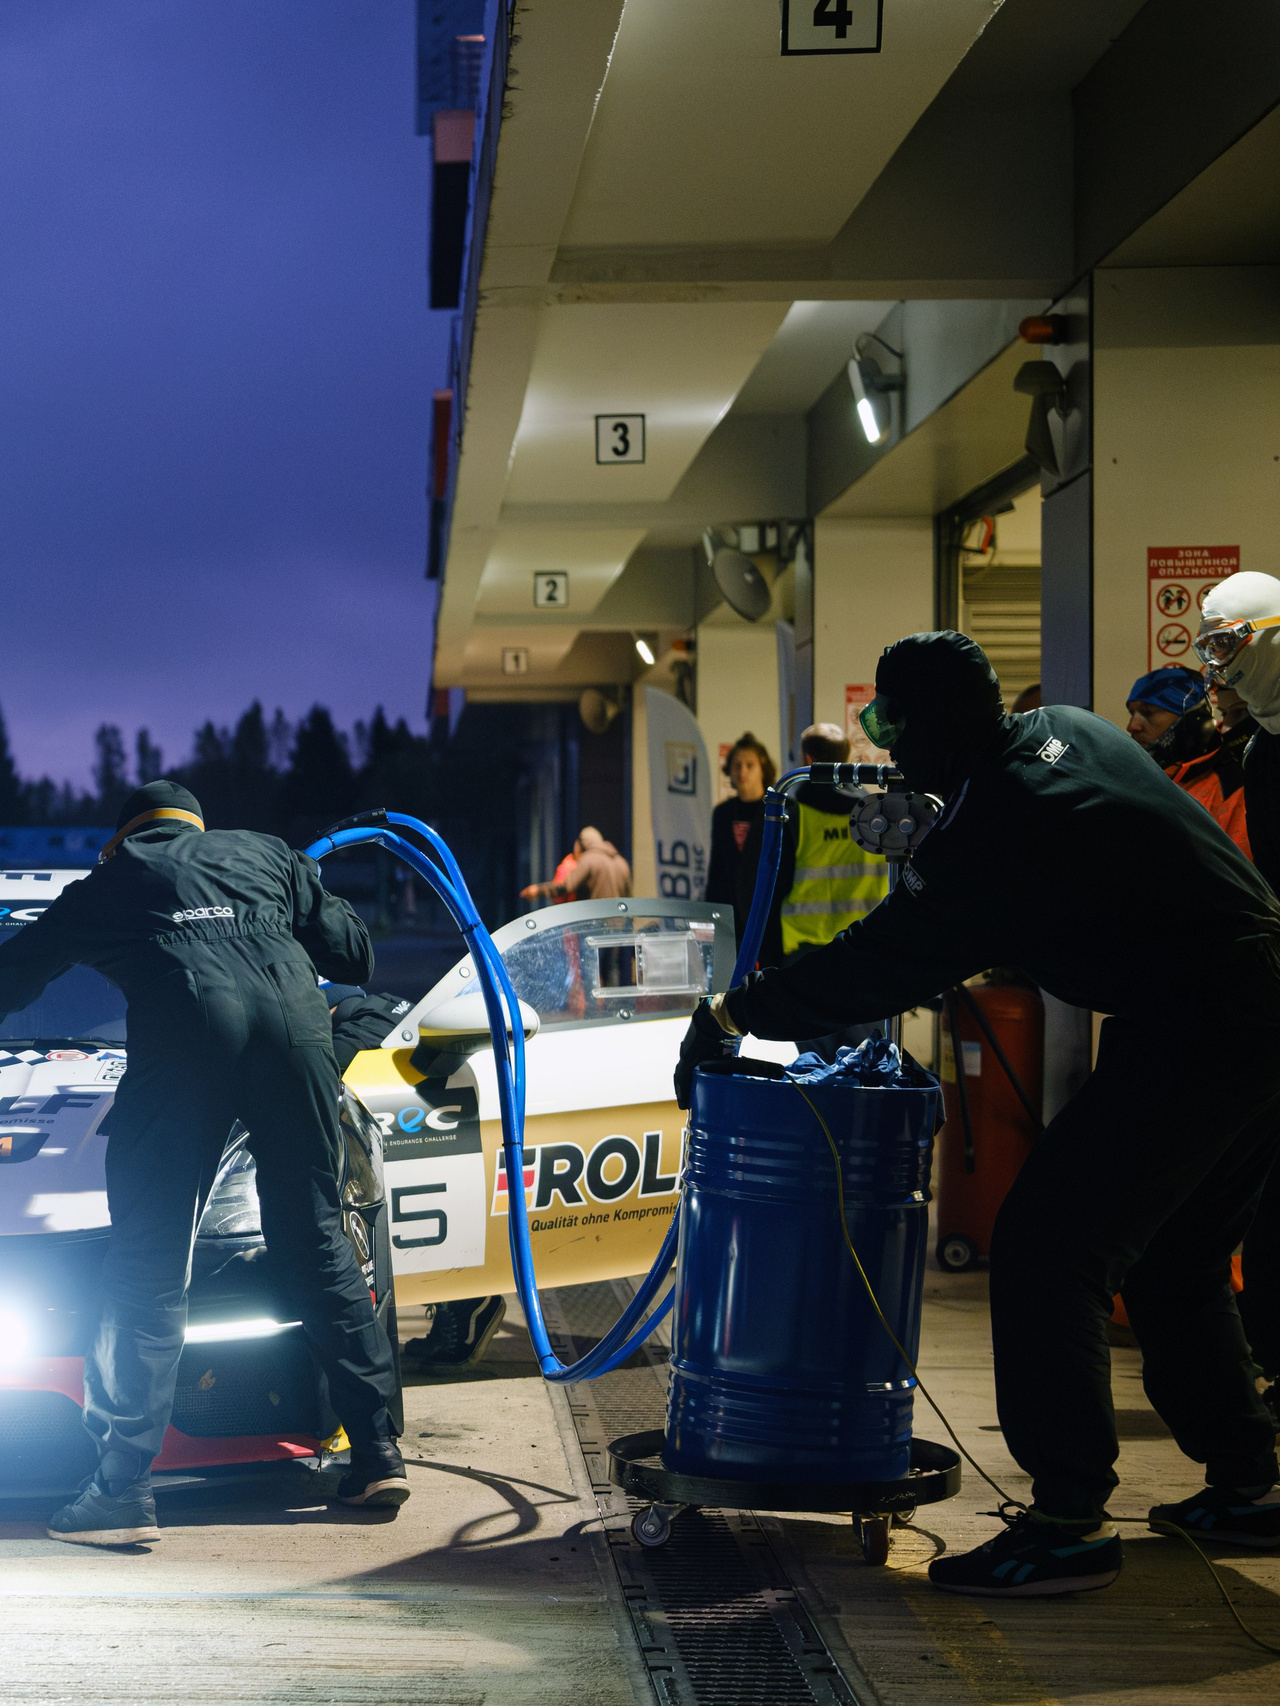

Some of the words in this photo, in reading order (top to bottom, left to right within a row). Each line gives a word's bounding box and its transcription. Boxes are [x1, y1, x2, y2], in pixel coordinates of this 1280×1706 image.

[813, 0, 853, 39] 4
[611, 421, 630, 457] 3
[1150, 557, 1237, 568] ПОВЫШЕННОЙ
[1178, 549, 1210, 558] ЗОНА
[1158, 566, 1232, 576] ОПАСНОСТИ
[545, 578, 559, 602] 2
[512, 653, 520, 671] 1
[1040, 738, 1065, 763] OMP
[389, 1138, 423, 1147] ENDURANCE
[424, 1134, 458, 1143] CHALLENGE
[535, 1131, 687, 1209] ROL
[390, 1182, 448, 1250] 5
[531, 1214, 579, 1232] Qualität
[581, 1212, 610, 1225] ohne
